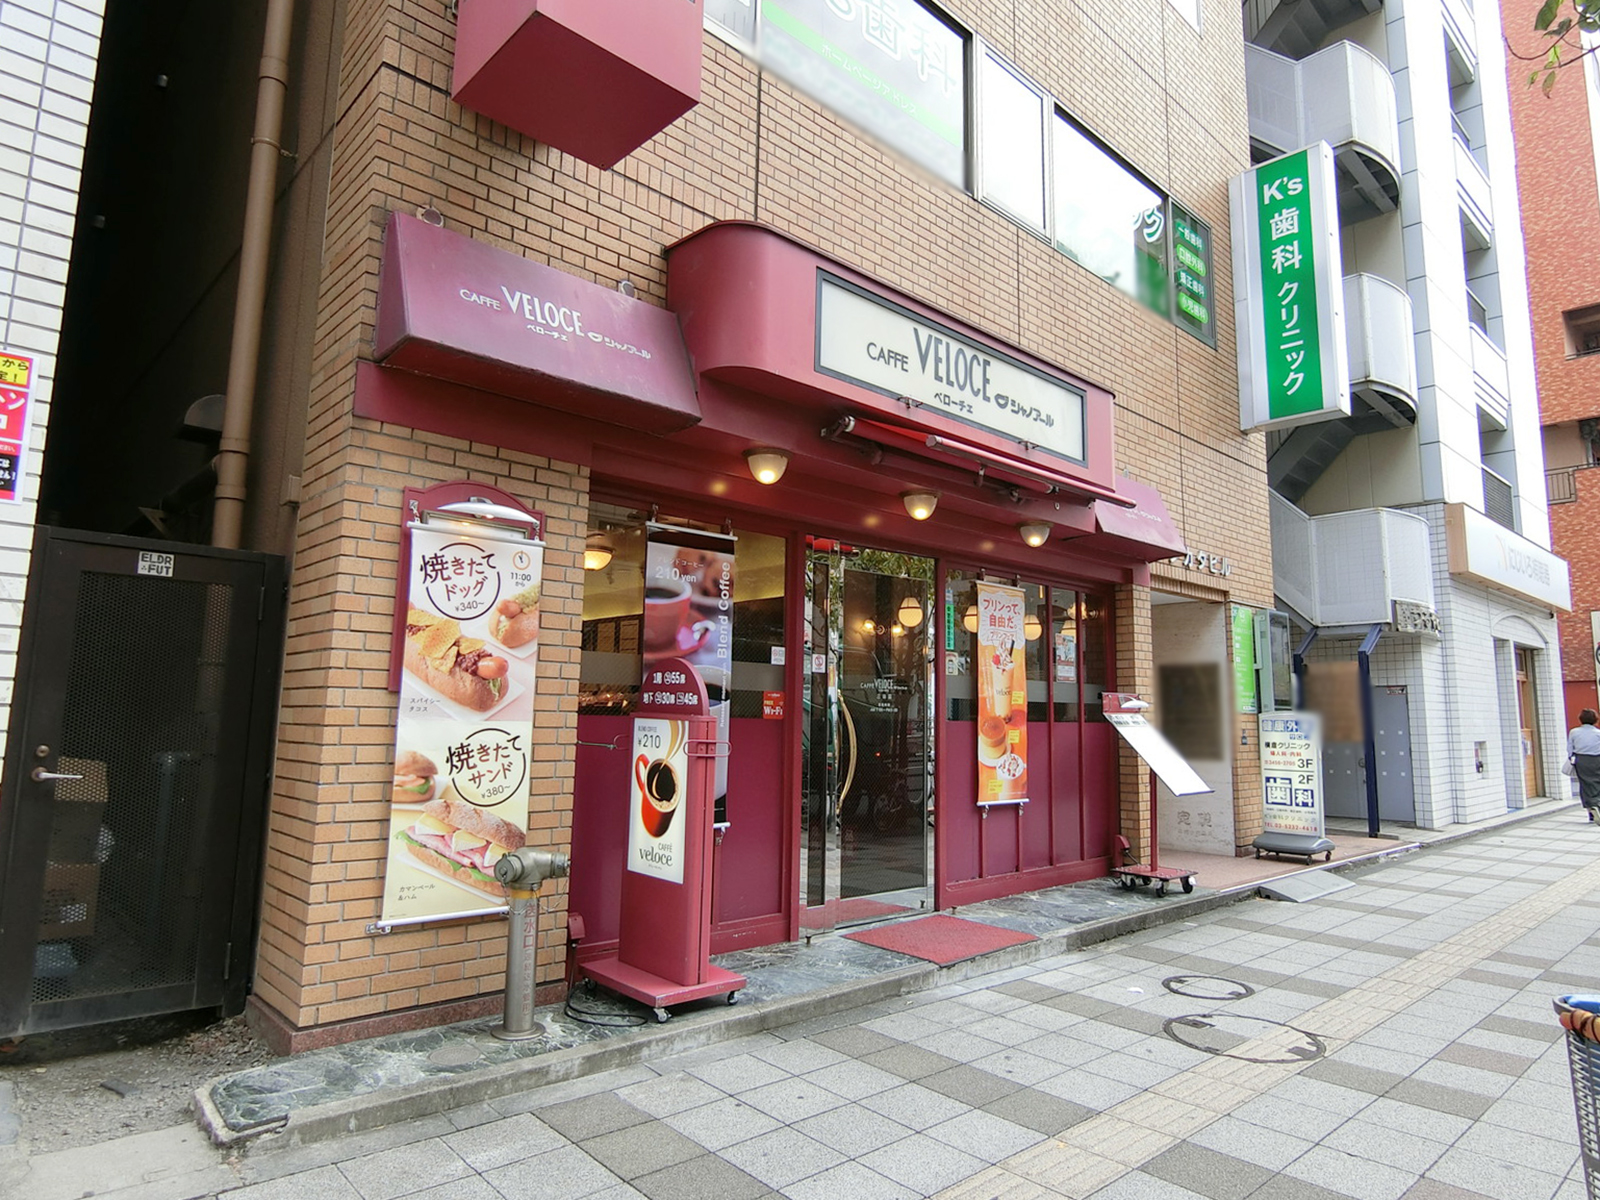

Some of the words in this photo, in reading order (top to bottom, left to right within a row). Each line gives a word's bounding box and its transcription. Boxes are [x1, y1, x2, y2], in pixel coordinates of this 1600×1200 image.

[1263, 176, 1304, 206] K's
[501, 285, 585, 338] VELOCE
[1269, 206, 1305, 396] 歯科クリニック
[912, 326, 992, 404] VELOCE
[933, 391, 975, 415] ベローチェ
[141, 552, 172, 566] ELDR
[420, 552, 497, 585] 焼きたて
[445, 576, 488, 602] ドッグ
[510, 571, 532, 582] 11:00
[681, 573, 697, 583] yen
[718, 562, 731, 611] Coffee
[717, 614, 729, 659] Blend
[763, 706, 783, 716] Wi-Fi
[445, 735, 523, 776] 焼きたて
[1297, 758, 1313, 769] 3F
[468, 762, 513, 789] サンド
[1298, 774, 1314, 785] 2F
[1265, 776, 1315, 808] 歯科
[638, 846, 673, 867] veloce
[523, 902, 537, 949] 送水口
